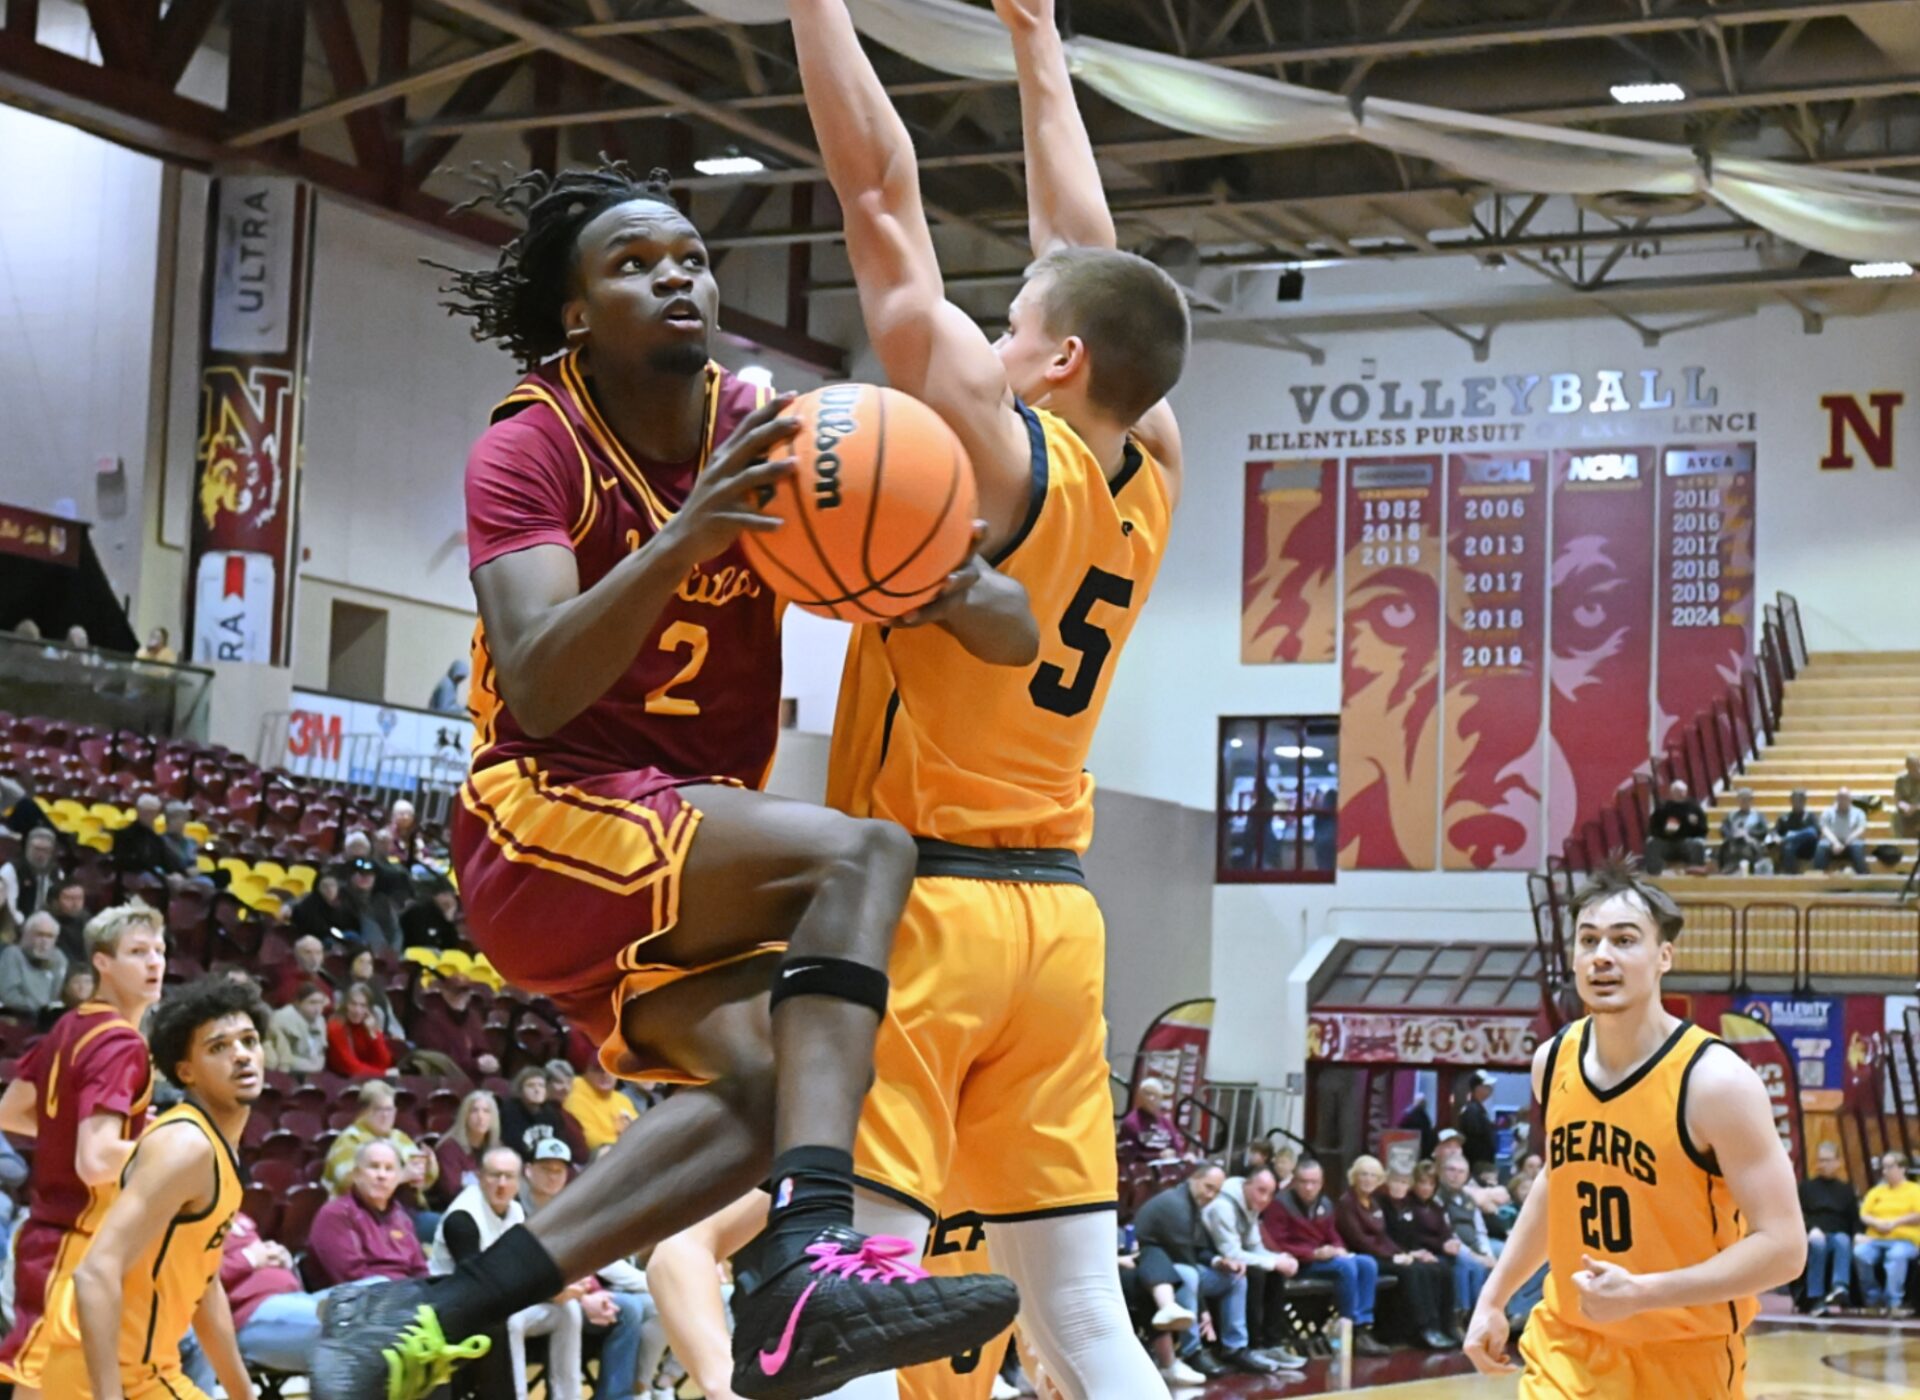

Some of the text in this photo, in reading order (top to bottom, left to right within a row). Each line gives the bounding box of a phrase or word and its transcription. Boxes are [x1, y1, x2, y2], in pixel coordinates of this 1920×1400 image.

[236, 188, 269, 313] ULTRA
[1288, 366, 1718, 424] VOLLEYBALL
[1248, 428, 1406, 452] RELENTLESS
[1416, 423, 1525, 445] PURSUIT
[1820, 391, 1904, 470] N
[816, 384, 859, 510] Wilson
[1687, 455, 1733, 470] AVCA
[1364, 500, 1421, 520] 1982
[1465, 499, 1525, 520] 2006
[1673, 513, 1720, 532] 2016
[1362, 546, 1420, 565] 2019
[1464, 535, 1524, 556] 2013
[1672, 537, 1720, 556] 2017
[1672, 560, 1720, 579] 2018
[1464, 572, 1523, 593] 2017
[1672, 582, 1720, 603] 2019
[1463, 609, 1523, 630] 2018
[1672, 606, 1720, 627] 2024
[1028, 565, 1135, 717] 5
[644, 620, 709, 715] 2
[288, 709, 342, 762] 3M
[1551, 1120, 1657, 1186] BEARS
[1576, 1180, 1633, 1253] 20
